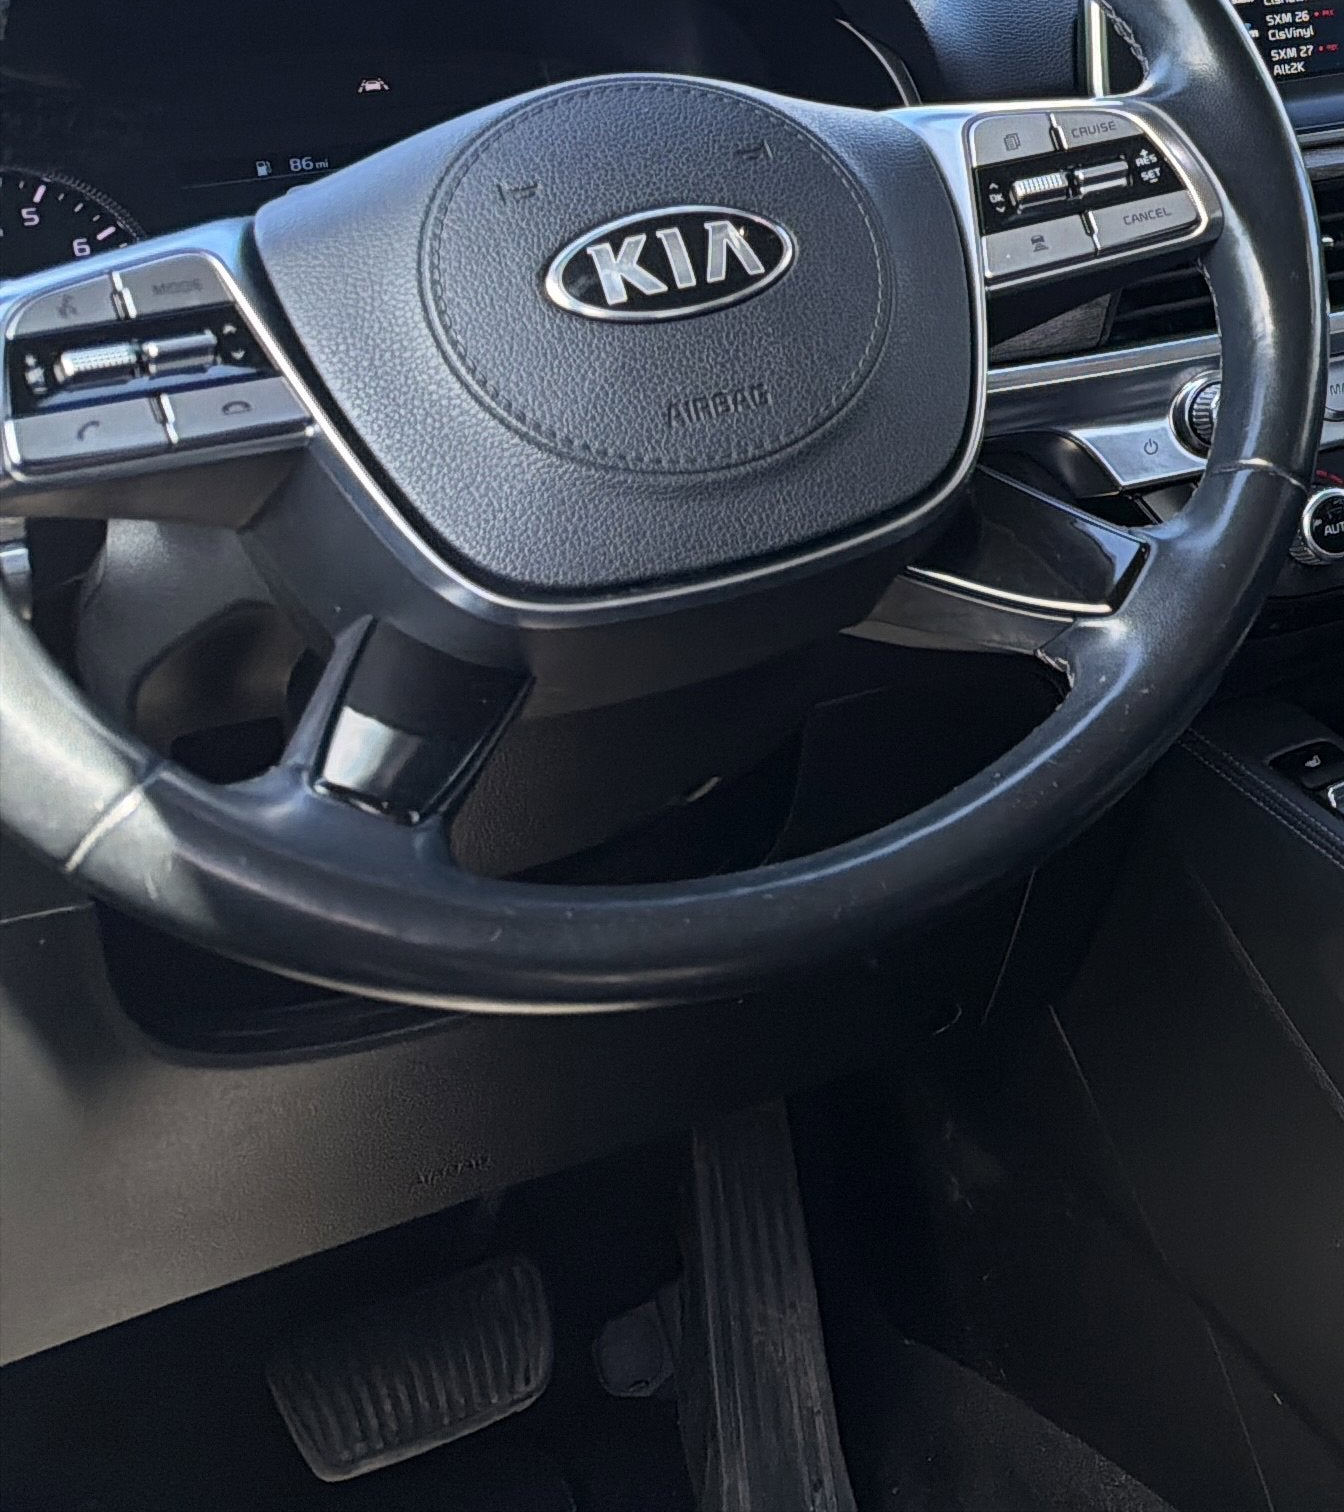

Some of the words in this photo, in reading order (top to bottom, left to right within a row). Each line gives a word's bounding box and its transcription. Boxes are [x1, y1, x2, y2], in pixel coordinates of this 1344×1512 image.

[1266, 13, 1293, 26] SXM
[1295, 10, 1310, 23] 26
[1268, 25, 1315, 41] ClsVinyl
[1271, 47, 1298, 61] SXM
[1299, 45, 1314, 57] 27
[1273, 61, 1306, 76] Alt2K
[1071, 120, 1117, 138] CRUISE
[289, 156, 314, 172] 86
[315, 158, 329, 170] mi
[1135, 155, 1158, 167] RES
[1141, 168, 1162, 181] SET
[989, 192, 1003, 203] OK
[21, 207, 40, 227] 5
[1123, 208, 1173, 226] CANCEL
[72, 238, 91, 256] 6
[586, 220, 765, 306] KIA
[667, 385, 772, 428] AIRBAG
